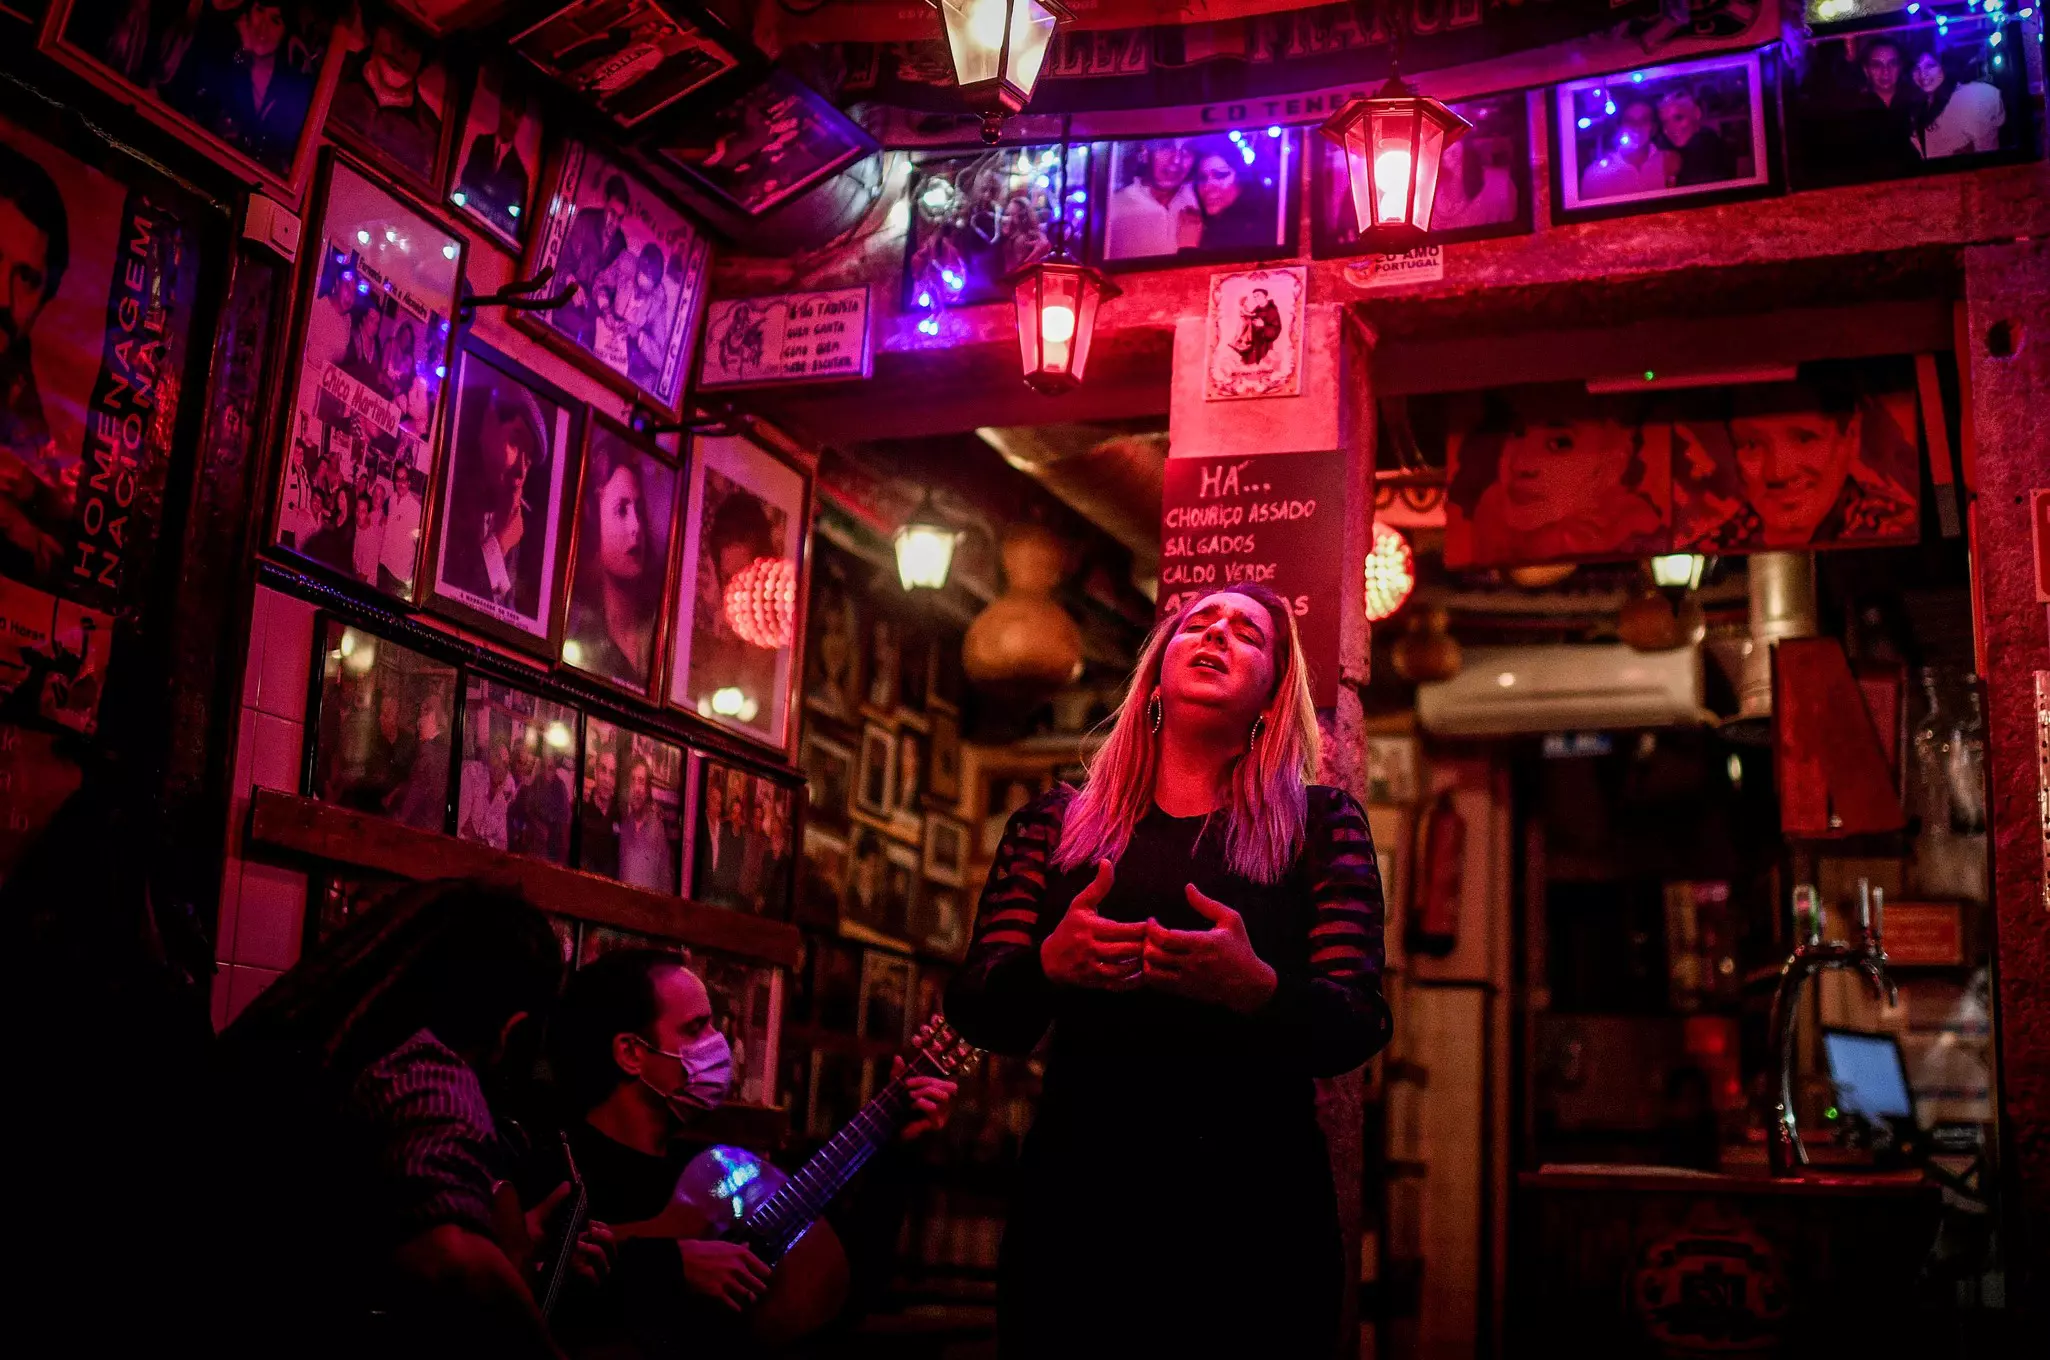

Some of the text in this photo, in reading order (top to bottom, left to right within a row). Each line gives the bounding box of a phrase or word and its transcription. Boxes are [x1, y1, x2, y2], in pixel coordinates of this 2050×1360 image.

[1375, 258, 1440, 272] PORTUGAL
[322, 364, 350, 401] Chico
[73, 215, 153, 578] HOMENAGEM
[97, 309, 166, 588] NACIONAL
[1248, 499, 1317, 523] ASSADO
[1164, 534, 1256, 558] SALGADOS
[1162, 560, 1278, 585] CALDO VERDE
